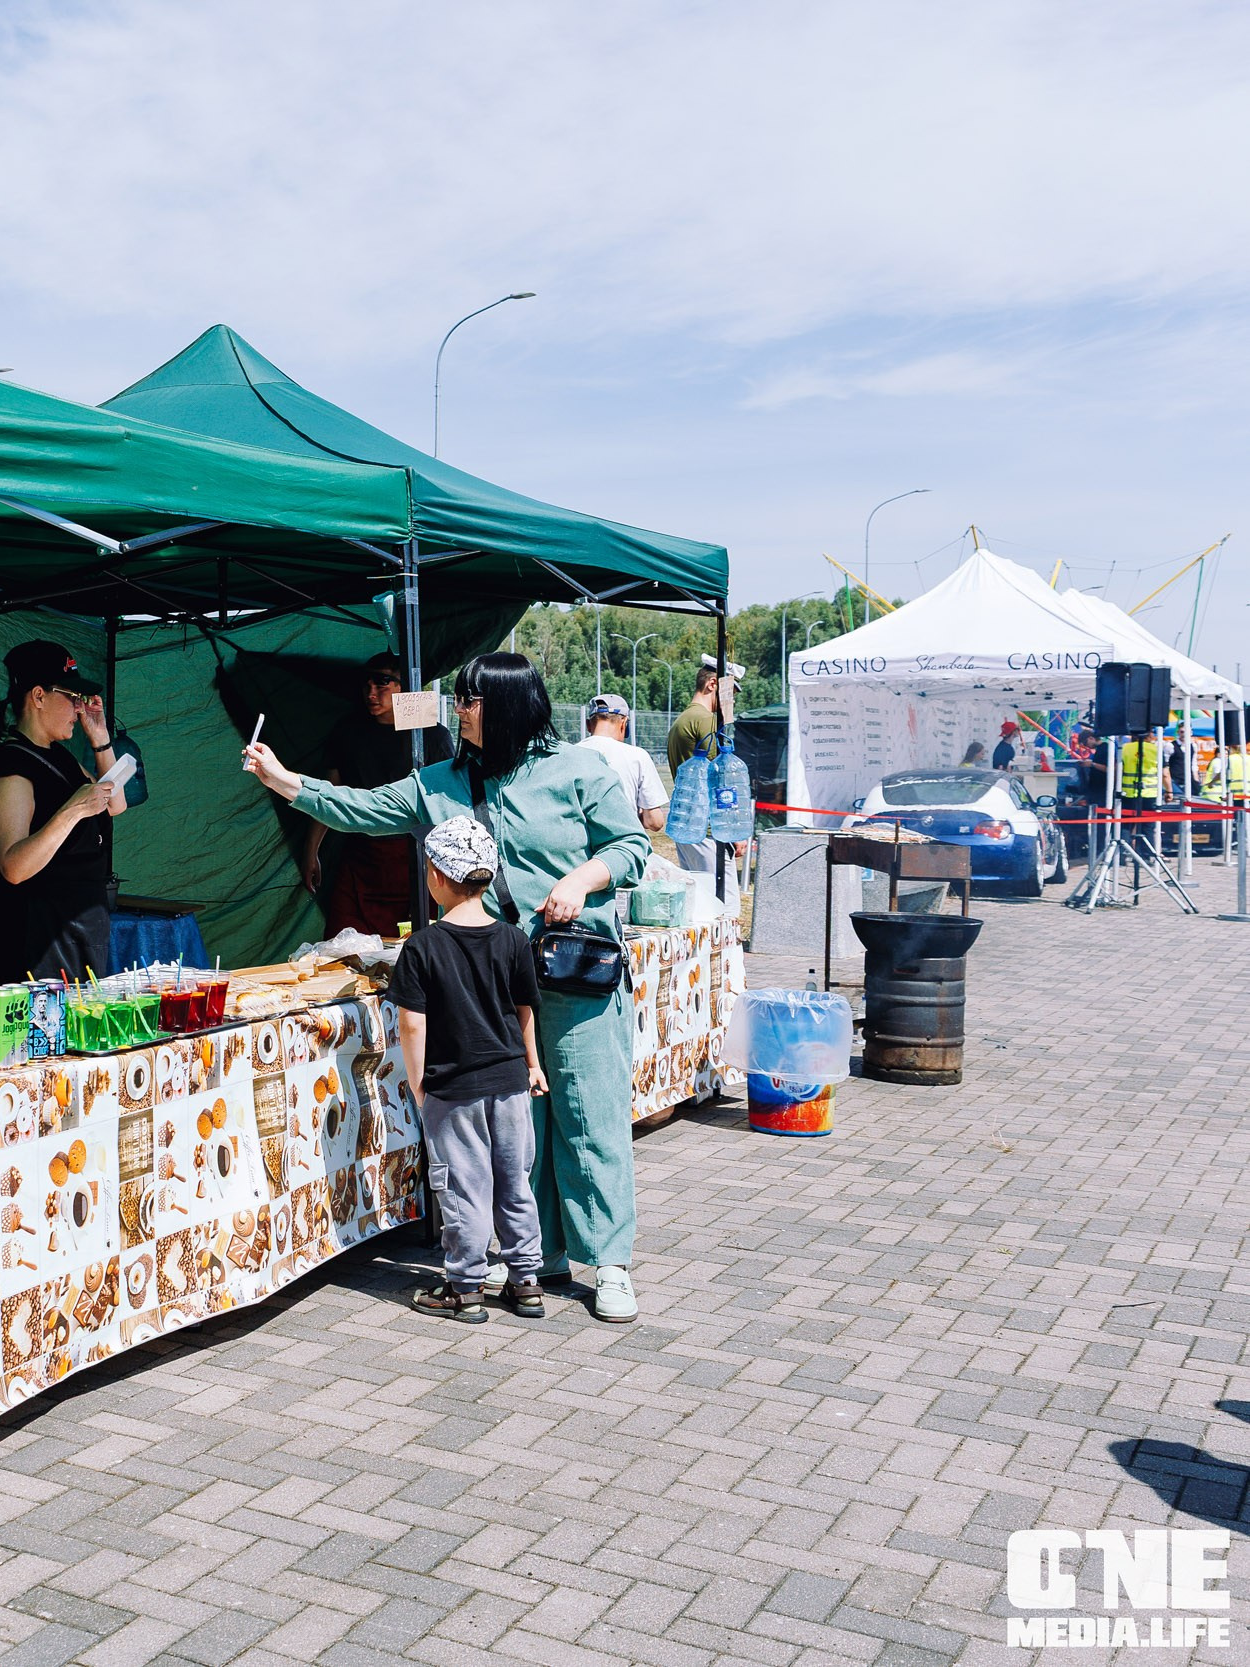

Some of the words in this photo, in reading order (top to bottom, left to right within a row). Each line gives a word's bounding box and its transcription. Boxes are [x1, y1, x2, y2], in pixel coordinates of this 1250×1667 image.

[801, 656, 887, 676] CASINO
[908, 654, 990, 673] Shambala
[1008, 652, 1101, 670] CASINO
